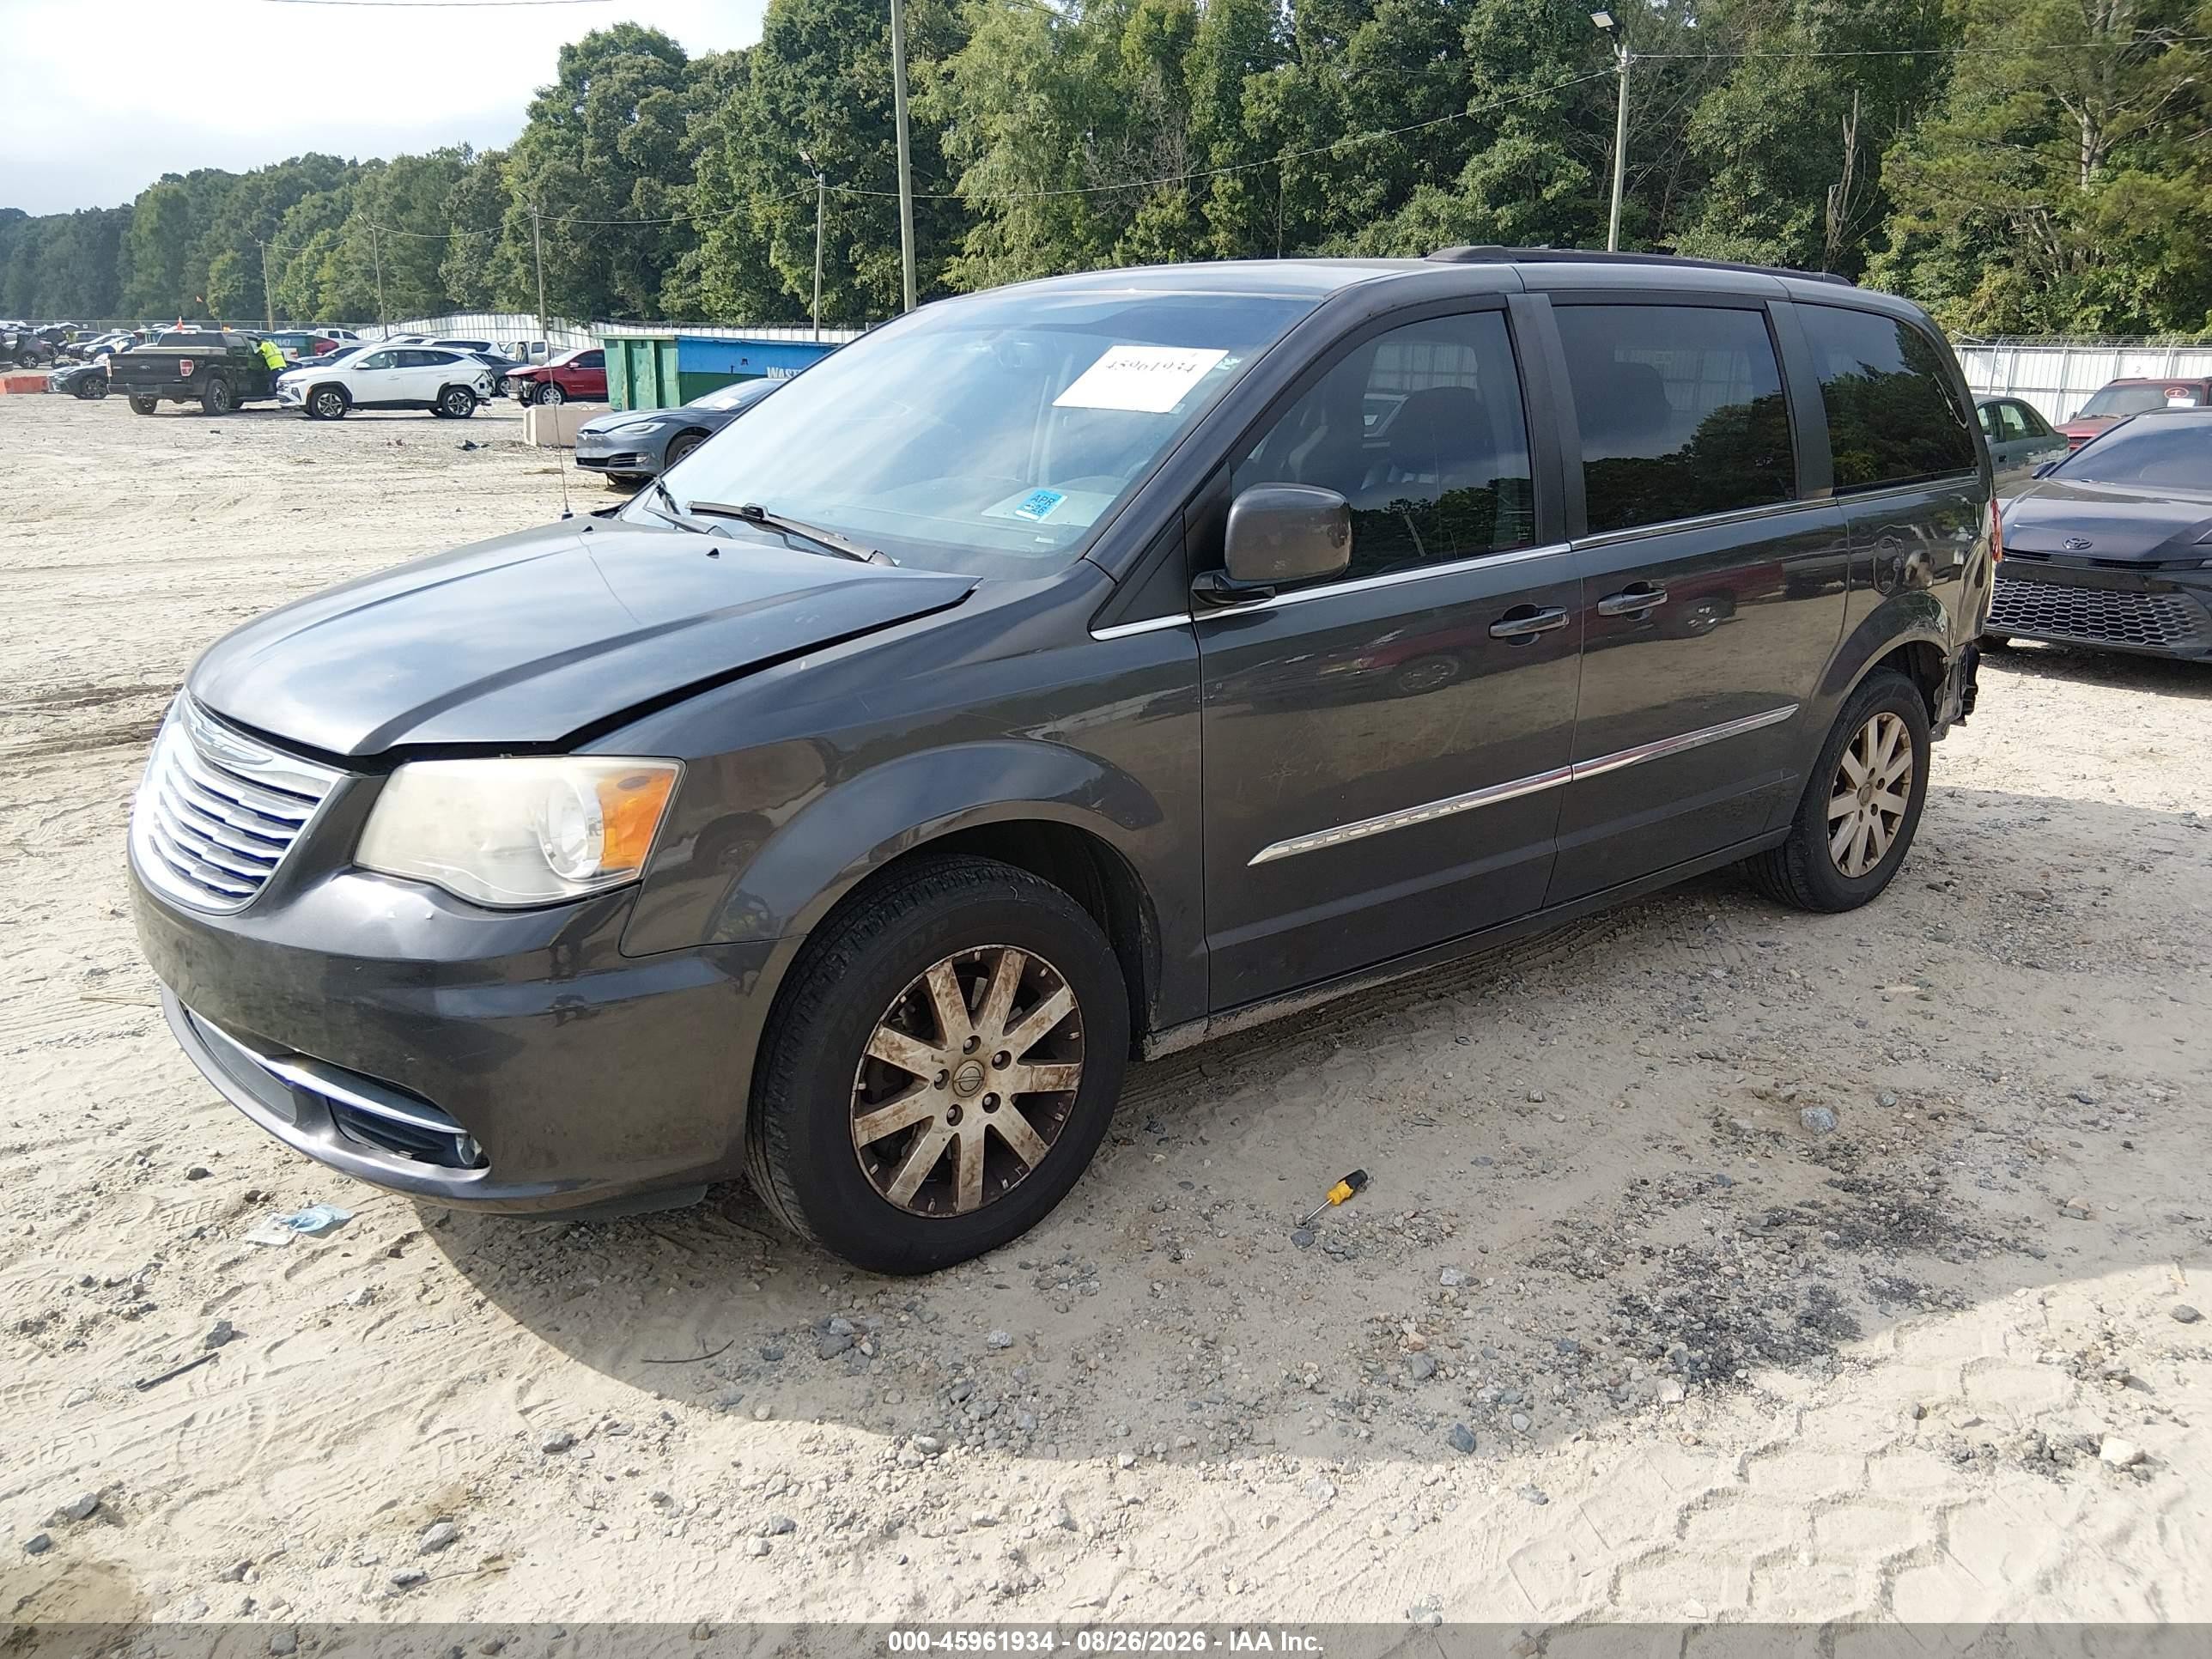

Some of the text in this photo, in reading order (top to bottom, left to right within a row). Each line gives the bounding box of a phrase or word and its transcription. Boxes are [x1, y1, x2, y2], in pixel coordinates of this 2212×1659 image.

[767, 367, 802, 379] WAST
[1031, 494, 1055, 507] APR
[1288, 802, 1461, 853] CHRYSLER
